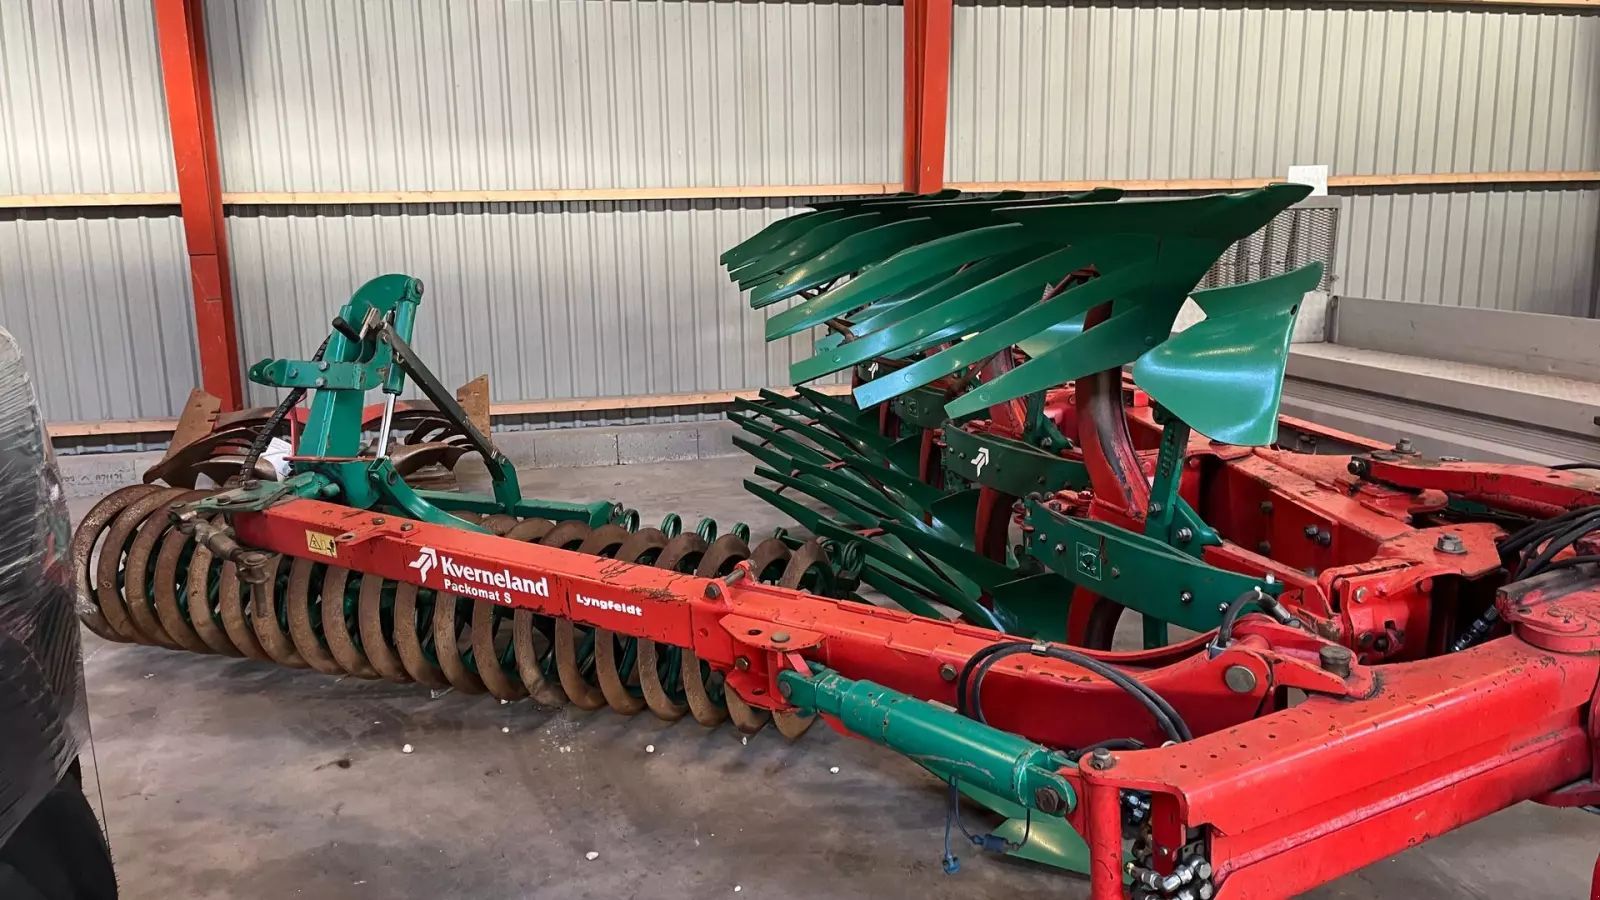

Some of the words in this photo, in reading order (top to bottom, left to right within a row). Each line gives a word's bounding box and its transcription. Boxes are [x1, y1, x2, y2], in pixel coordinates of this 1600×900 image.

[440, 556, 549, 597] Kverneland
[444, 578, 500, 602] Packomat
[504, 593, 512, 605] S
[576, 594, 643, 617] Lyngfeldt
